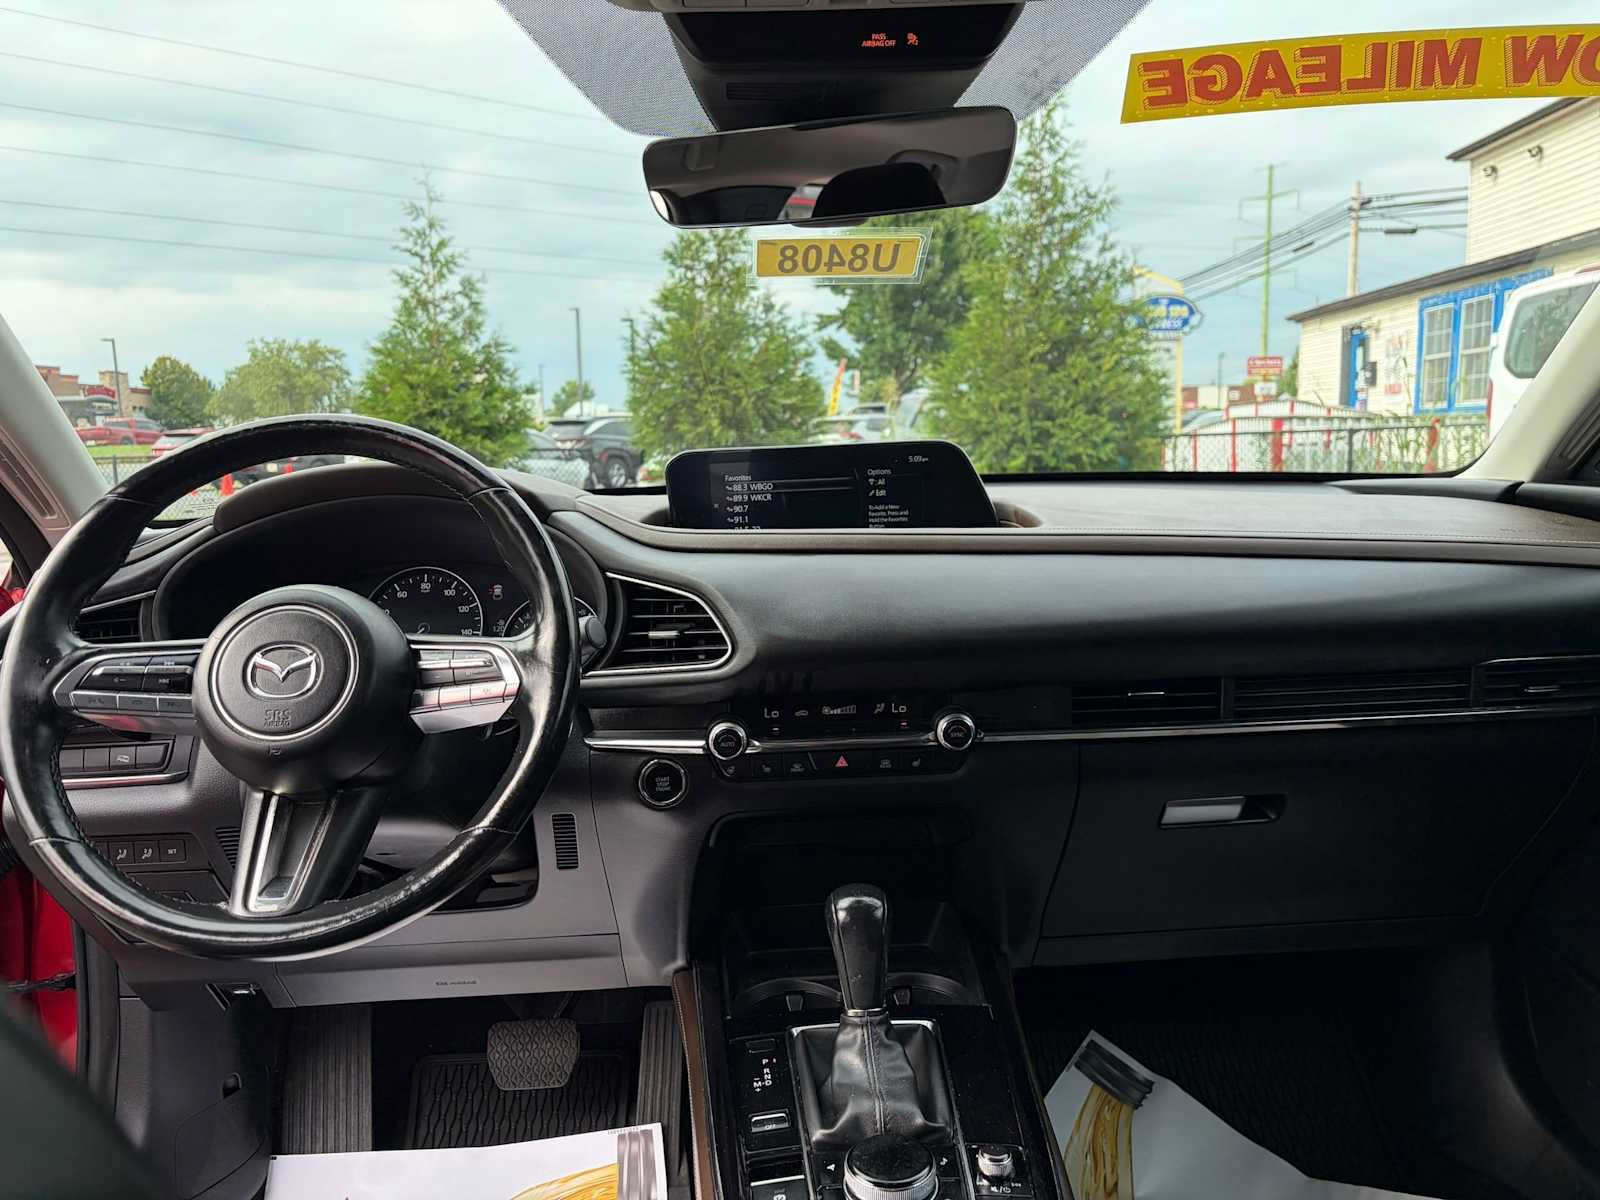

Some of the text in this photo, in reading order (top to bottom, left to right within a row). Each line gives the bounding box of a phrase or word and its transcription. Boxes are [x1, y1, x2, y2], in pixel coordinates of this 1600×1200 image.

[733, 483, 773, 491] 88.3 WBGO
[733, 493, 772, 502] 89.9 WKCR
[420, 582, 431, 590] 80
[443, 589, 456, 597] 100
[458, 605, 470, 613] 120
[461, 628, 473, 636] 140
[892, 703, 907, 713] Lo
[265, 709, 291, 721] SRS
[764, 707, 780, 718] Lo
